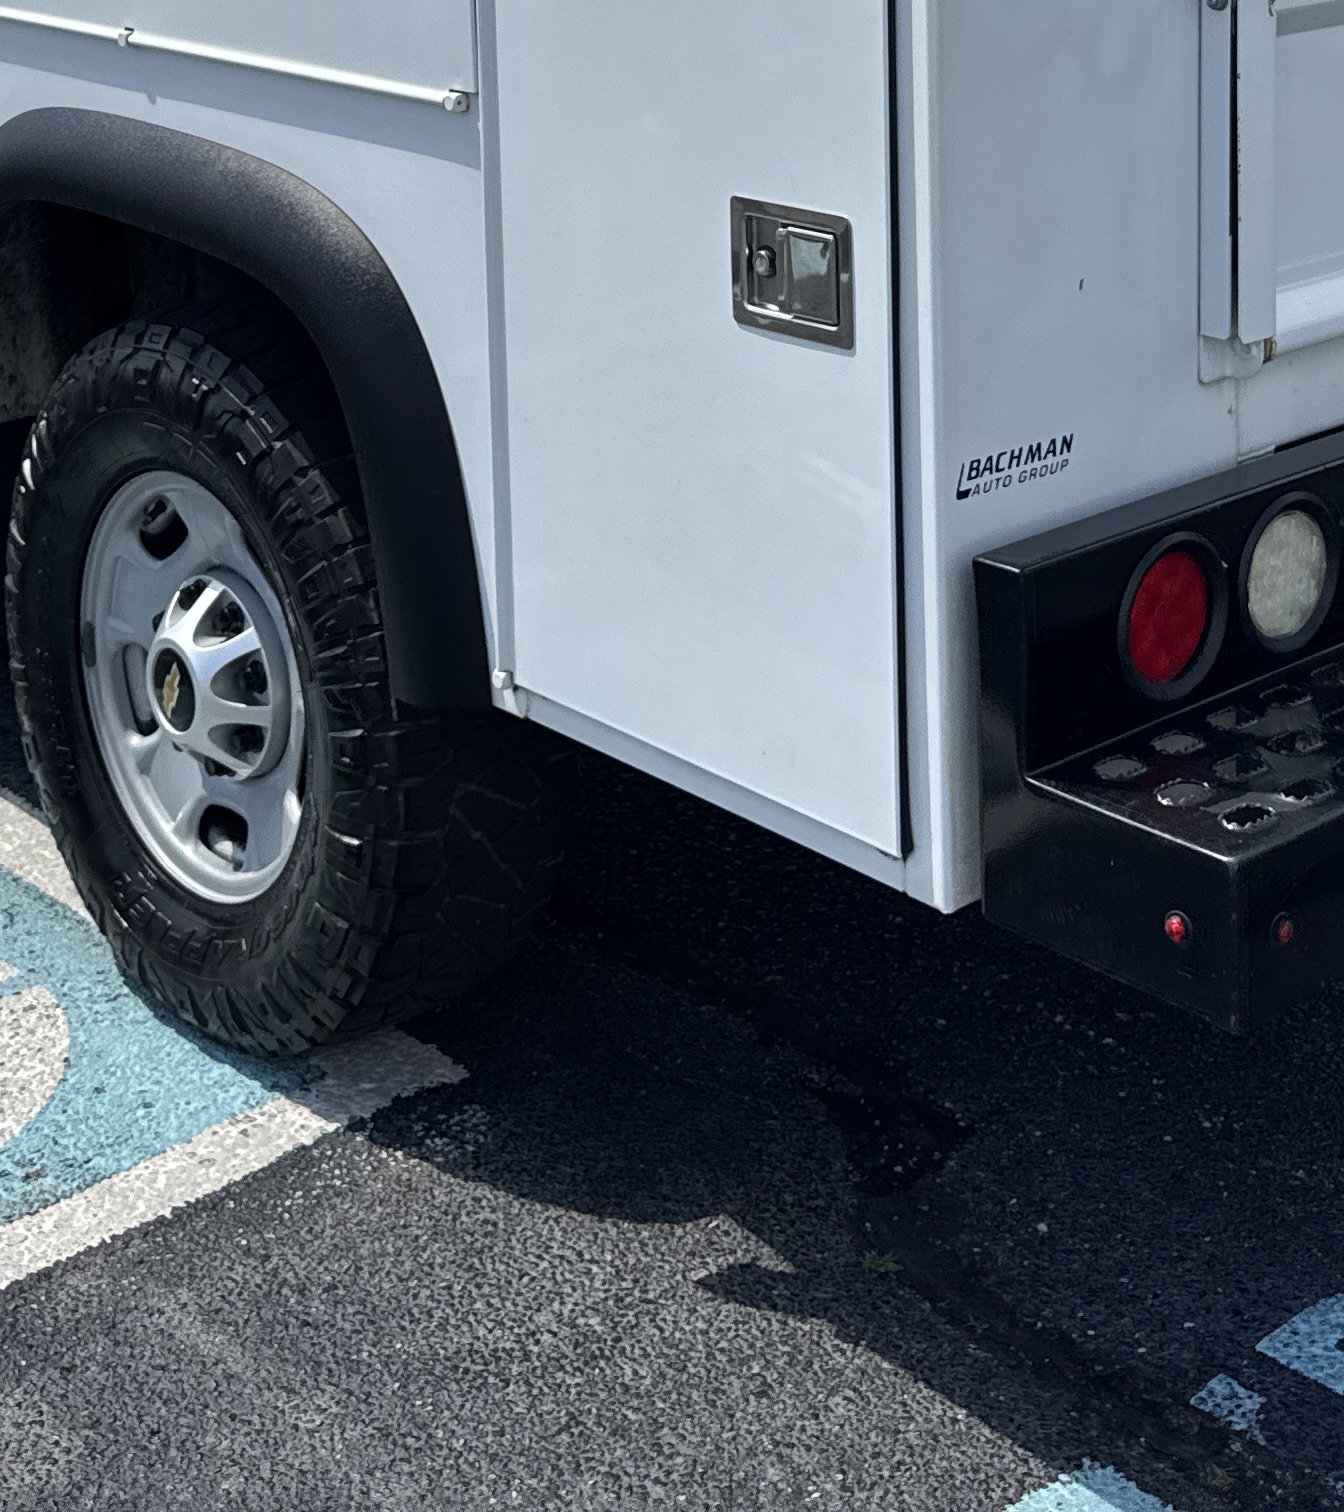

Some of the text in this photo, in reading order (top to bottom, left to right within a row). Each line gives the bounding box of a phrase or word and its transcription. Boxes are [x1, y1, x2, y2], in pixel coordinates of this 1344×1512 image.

[967, 433, 1074, 481] BACHMAN
[971, 458, 1069, 497] AUTO GROUP
